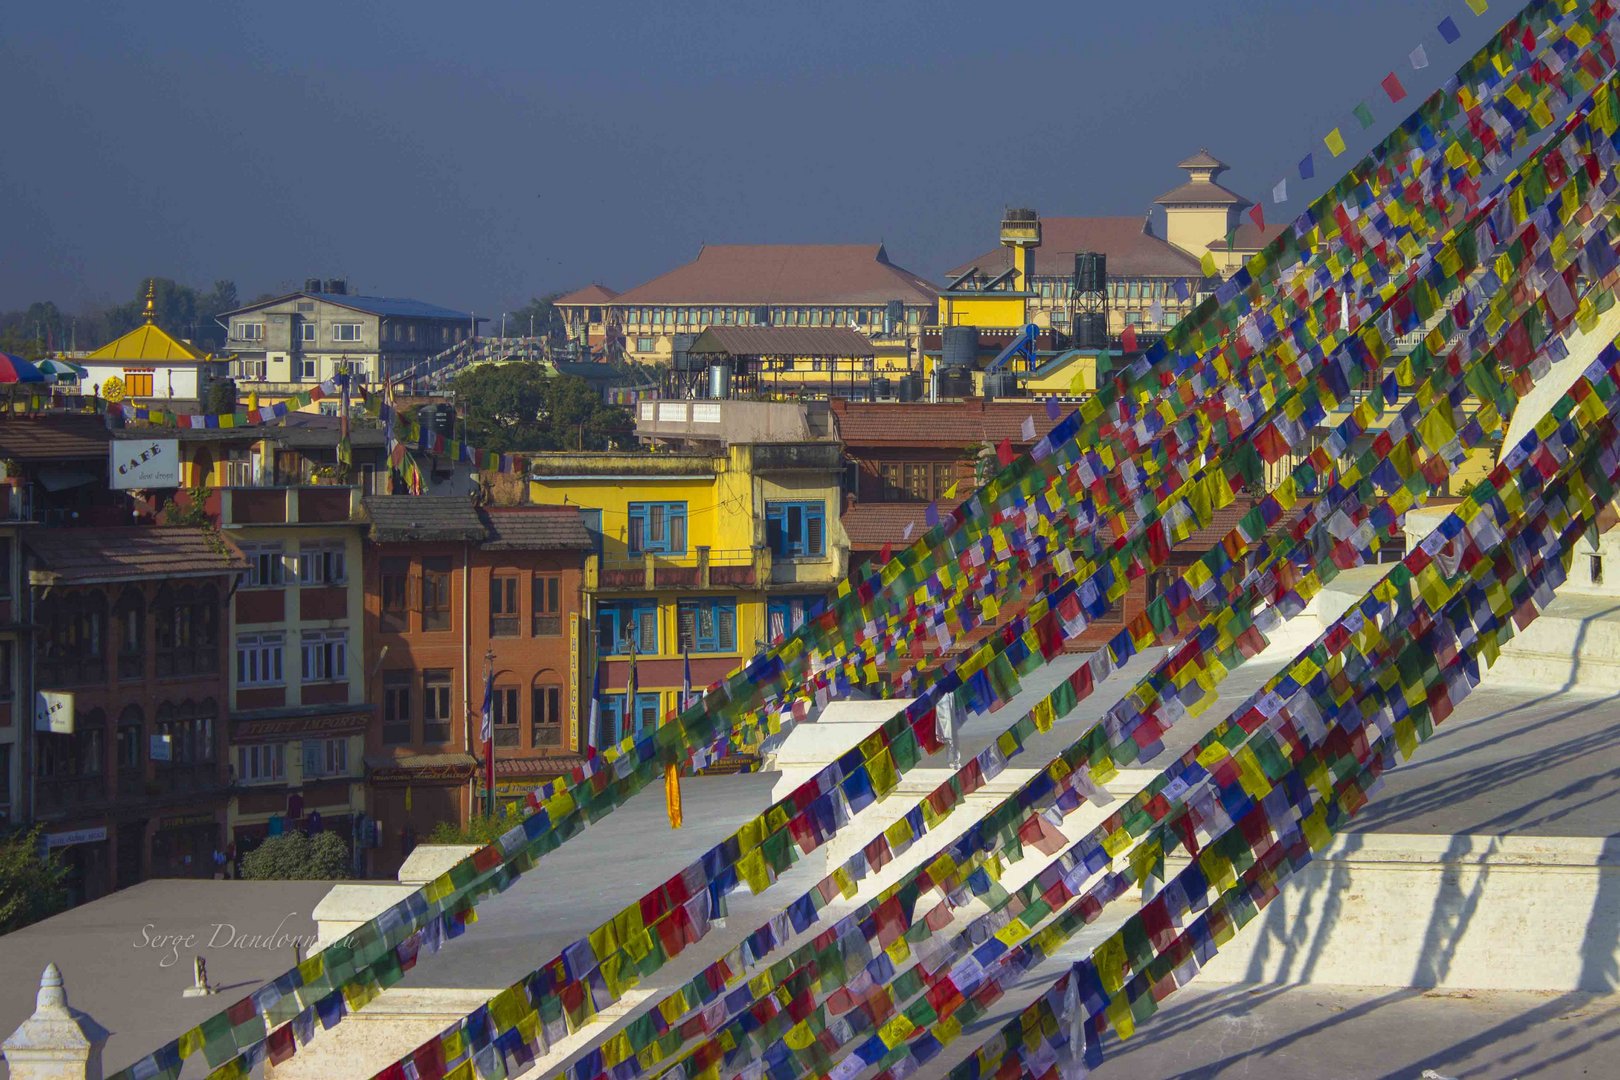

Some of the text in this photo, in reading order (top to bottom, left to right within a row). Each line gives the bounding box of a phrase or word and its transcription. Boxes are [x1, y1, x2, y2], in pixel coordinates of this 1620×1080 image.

[118, 442, 161, 475] CAFÉ
[250, 713, 370, 735] TIBET IMPORTS
